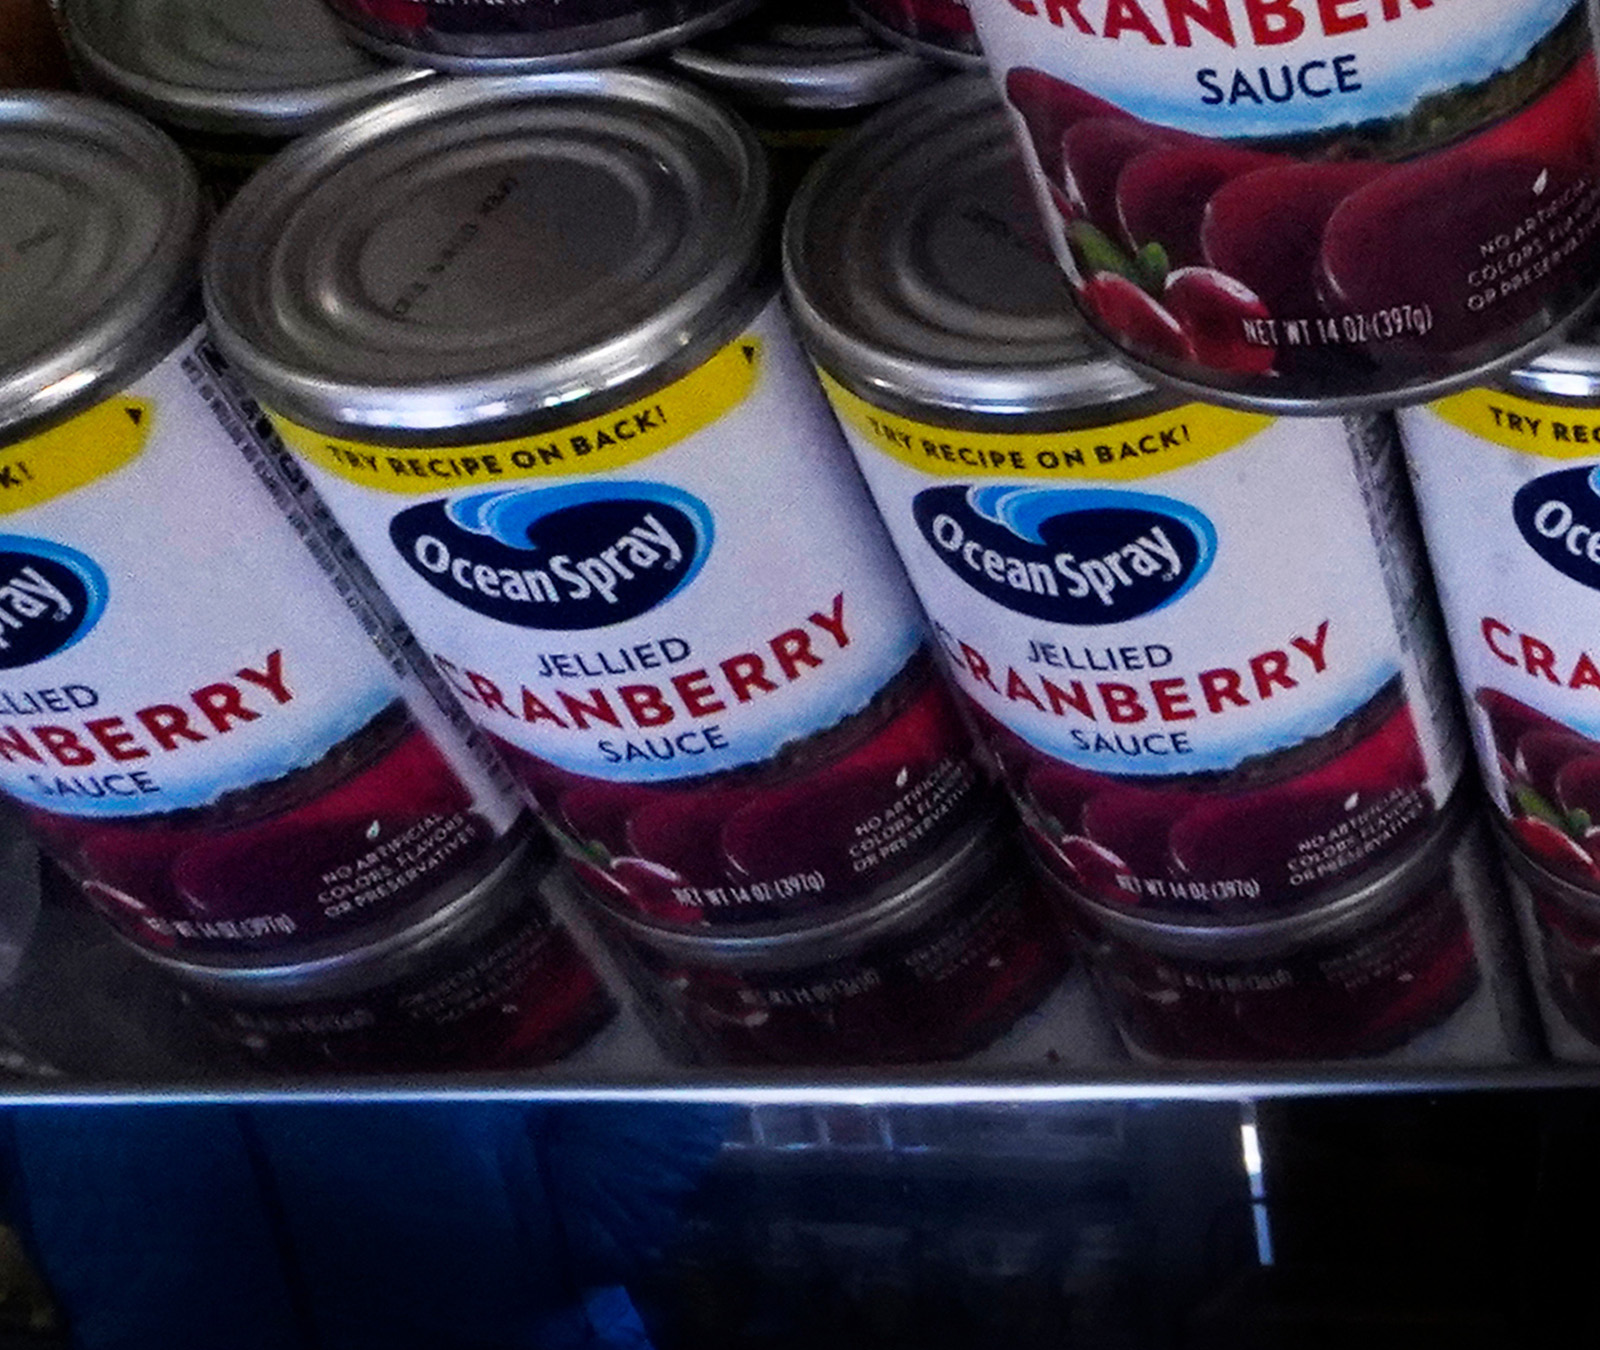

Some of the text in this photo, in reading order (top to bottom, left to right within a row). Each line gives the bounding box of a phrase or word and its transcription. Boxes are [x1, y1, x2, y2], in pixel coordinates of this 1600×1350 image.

[1197, 53, 1363, 106] SAUCE
[1244, 318, 1278, 345] NET
[1282, 319, 1311, 345] WT
[1316, 317, 1340, 344] 14
[1343, 315, 1368, 342] OZ
[327, 405, 667, 479] TRY RECIPE ON BACK!
[868, 417, 1192, 471] TRY RECIPE ON BACK!
[1488, 406, 1542, 441] TRY
[0, 566, 73, 650] ray
[434, 592, 852, 731] CRANBERRY
[538, 636, 692, 679] JELLIED
[933, 619, 1330, 725] CRANBERRY
[1027, 639, 1173, 671] JELLIED
[0, 685, 99, 714] LIED
[0, 649, 293, 767] NBERRY
[598, 725, 729, 765] SAUCE
[1069, 728, 1193, 758] SAUCE
[28, 771, 160, 798] SAUCE
